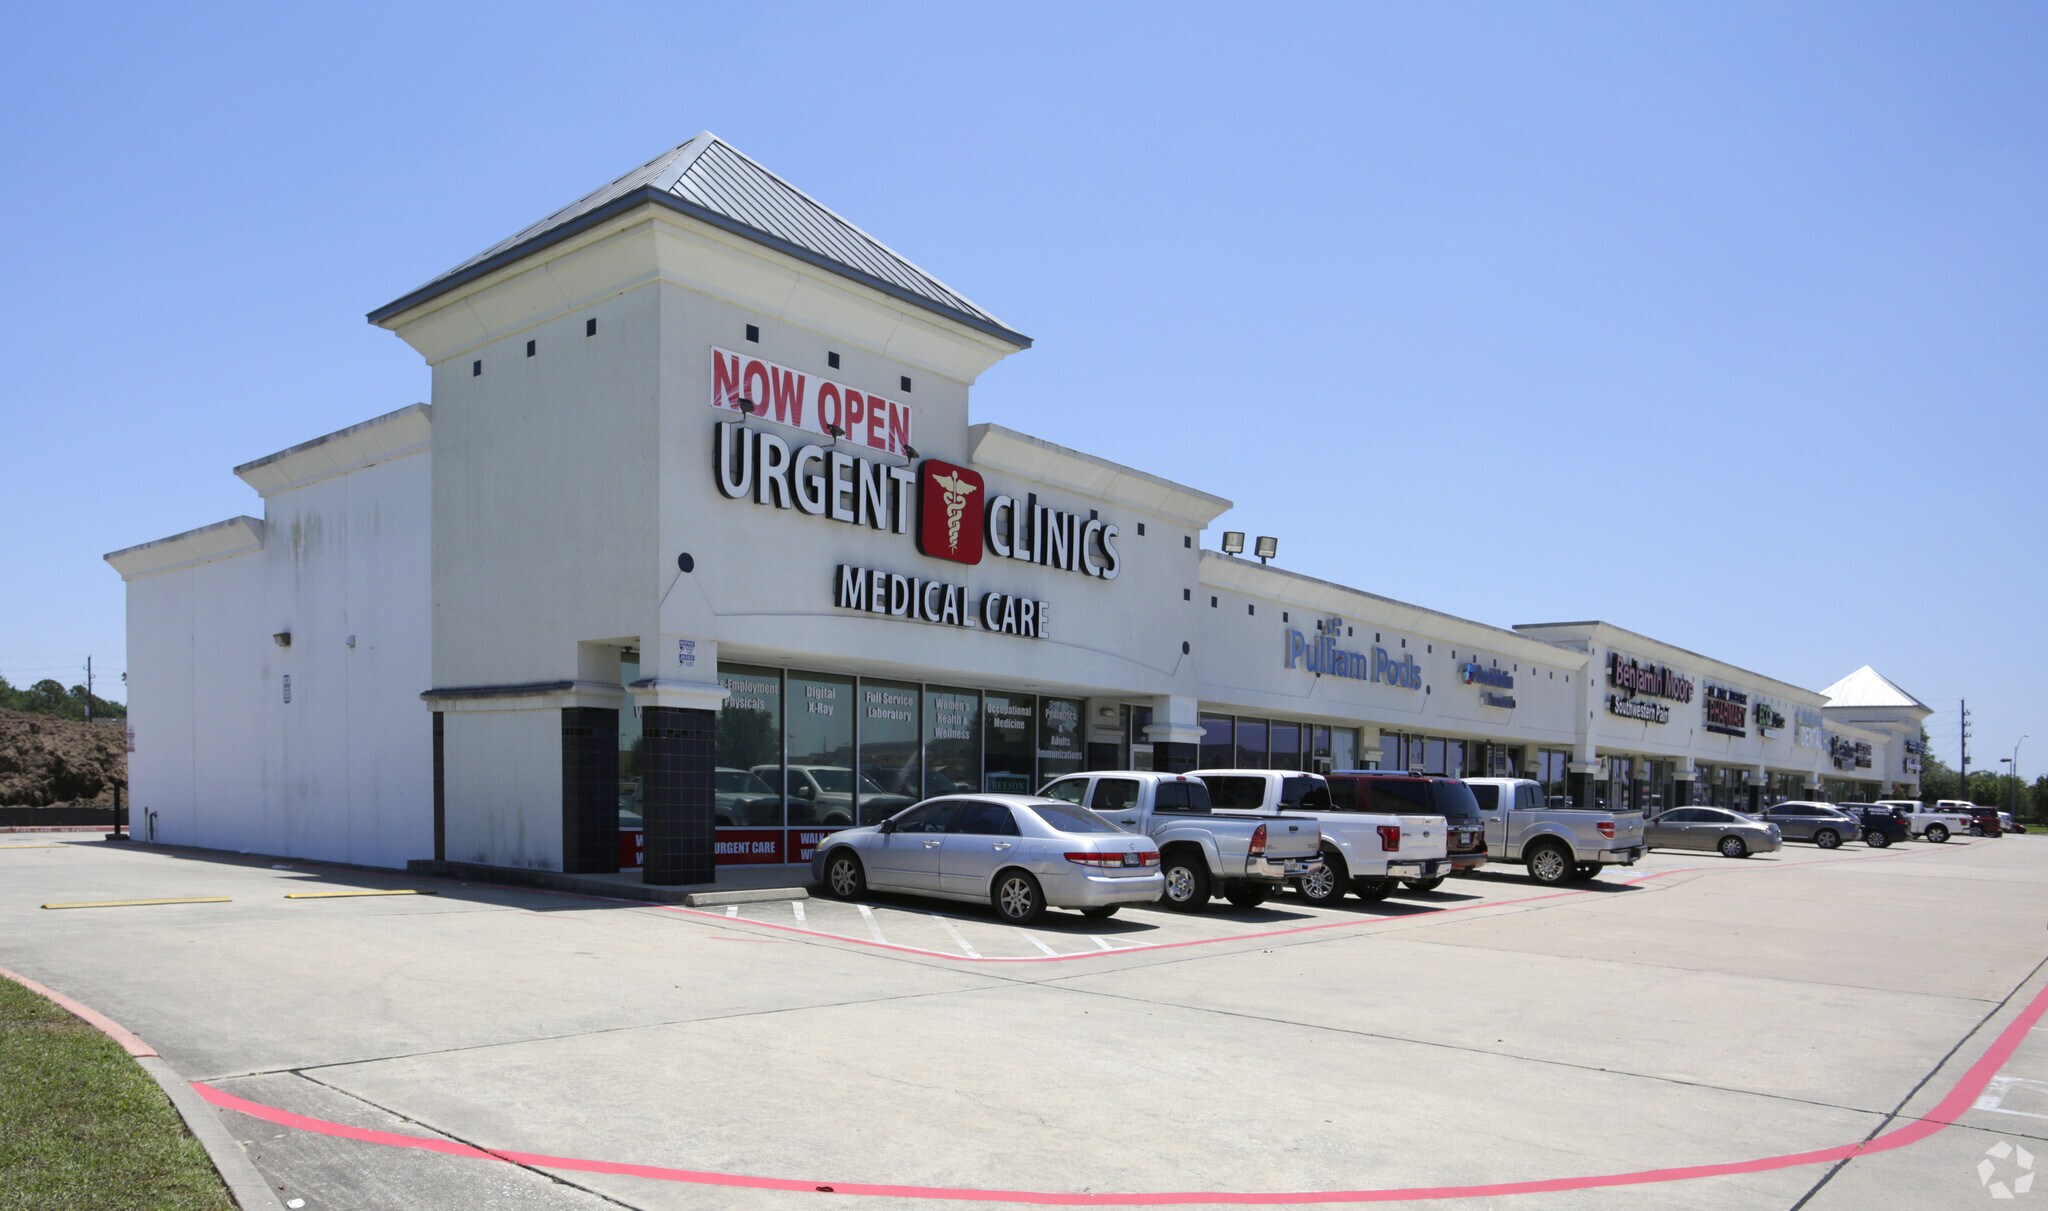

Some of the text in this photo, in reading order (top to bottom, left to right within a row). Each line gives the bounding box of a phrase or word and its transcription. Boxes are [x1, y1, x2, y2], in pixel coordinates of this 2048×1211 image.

[713, 348, 910, 457] NOW OPEN
[716, 421, 1120, 580] URGENT CLINICS
[835, 564, 1050, 639] MEDICAL CARE
[1285, 629, 1367, 681] Pulliam
[1370, 646, 1422, 690] Pools
[1614, 655, 1662, 696] Benjamin
[1664, 668, 1695, 702] Moore
[718, 679, 778, 695] e-Employment
[806, 686, 836, 700] Digital
[724, 696, 765, 710] Physicals
[866, 691, 913, 706] Full Service
[935, 698, 970, 711] Women's
[808, 702, 834, 716] X-Ray
[867, 707, 912, 721] Laboratory
[987, 703, 1032, 717] Occupational
[1045, 708, 1078, 721] Pediatrics
[1614, 696, 1655, 720] Southwestern
[937, 713, 968, 725] Health &
[993, 717, 1025, 730] Medicine
[935, 727, 970, 740] Wellness
[1058, 724, 1064, 733] &
[1050, 735, 1071, 747] Adults
[1037, 748, 1083, 760] Immunizations
[991, 779, 1025, 790] BEESON
[714, 841, 776, 854] URGENT CARE
